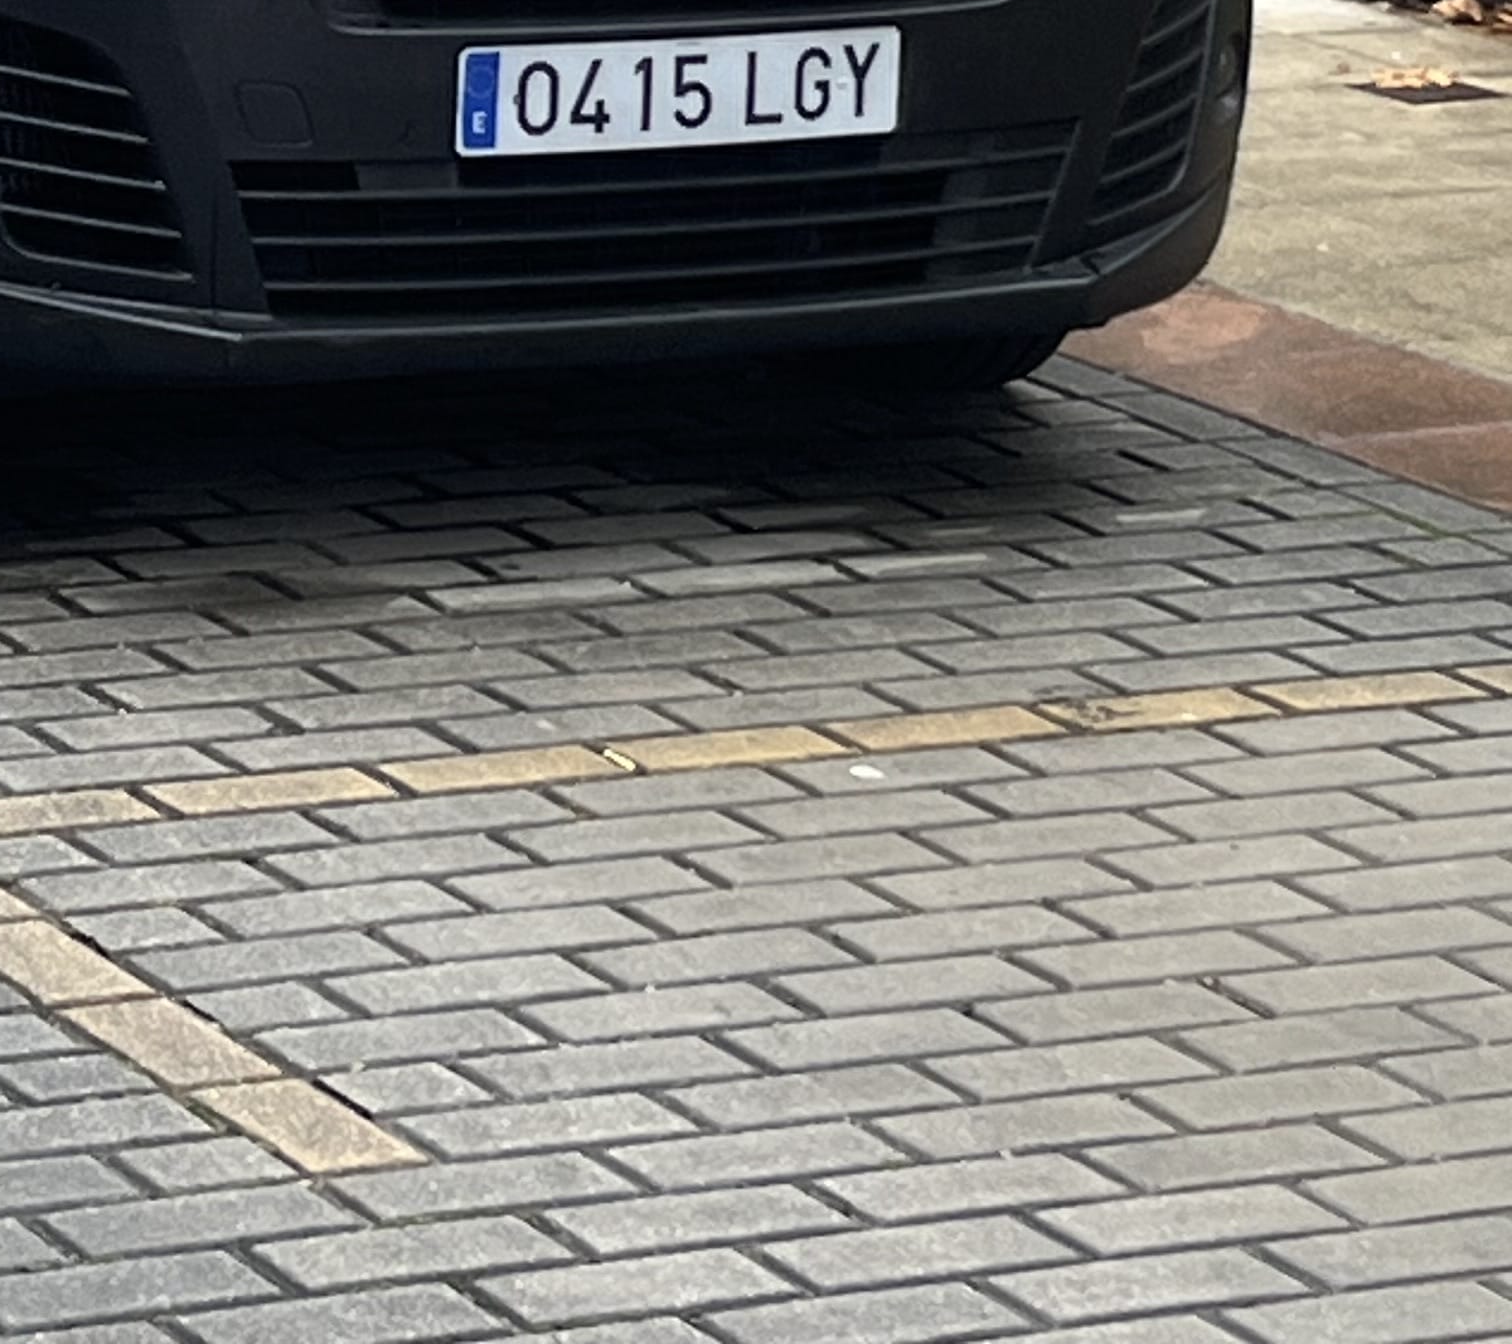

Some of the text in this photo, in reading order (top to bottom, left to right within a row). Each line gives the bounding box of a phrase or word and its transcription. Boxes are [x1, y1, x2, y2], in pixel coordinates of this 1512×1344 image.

[517, 42, 881, 136] 0415 LGY
[472, 110, 487, 135] E
